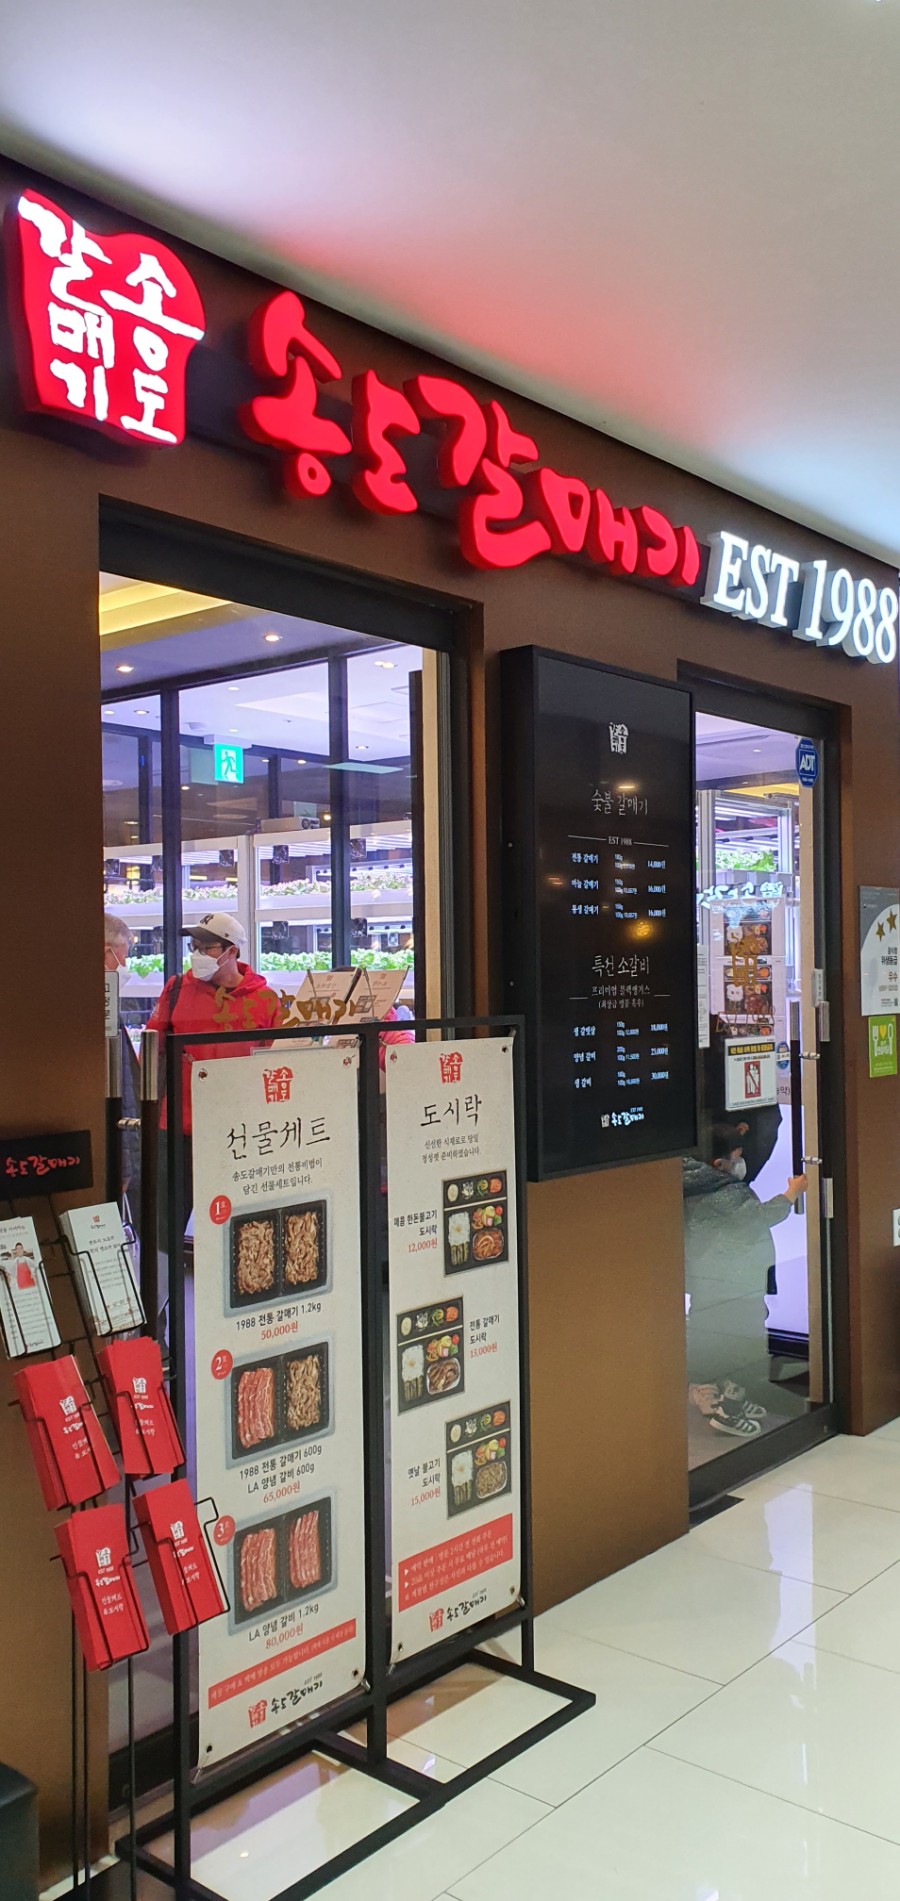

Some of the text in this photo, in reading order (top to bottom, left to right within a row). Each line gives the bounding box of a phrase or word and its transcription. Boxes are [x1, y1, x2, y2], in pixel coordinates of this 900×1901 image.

[241, 289, 701, 588] 송도갈매기
[705, 530, 899, 664] EST 1988
[800, 754, 815, 771] ADT
[592, 789, 648, 816] 숯불 갈매기
[608, 836, 619, 845] EST
[592, 954, 649, 978] 특선 소갈비
[591, 985, 617, 996] 프리미엄
[420, 1093, 482, 1127] 도시락
[227, 1117, 331, 1160] 선물세트
[5, 1154, 81, 1178] 송도갈매기
[232, 1163, 285, 1182] 송도갈매기만의
[242, 1175, 313, 1195] 담긴 선물세트입니다.
[407, 1209, 438, 1226] 한돈불고기
[419, 1225, 438, 1237] 도시락
[408, 1238, 438, 1253] 12,000원
[236, 1302, 322, 1331] 1988 전통 갈매기 1.2kg
[469, 1313, 500, 1332] 전통 갈매기
[261, 1320, 298, 1341] 50,000원
[470, 1331, 487, 1345] 도시락
[239, 1444, 322, 1480] 1988 전통 갈매기 600g
[422, 1457, 441, 1474] 불고기
[248, 1462, 315, 1494] LA 양념 갈비 600g
[422, 1472, 441, 1488] 도시락
[263, 1480, 301, 1503] 65,000원
[411, 1486, 441, 1507] 15,000원
[446, 1595, 487, 1621] 송도갈매기
[249, 1603, 319, 1642] LA 양념 갈비 1.2kg
[265, 1622, 304, 1649] 80,000원
[270, 1680, 323, 1715] 송도갈매기
